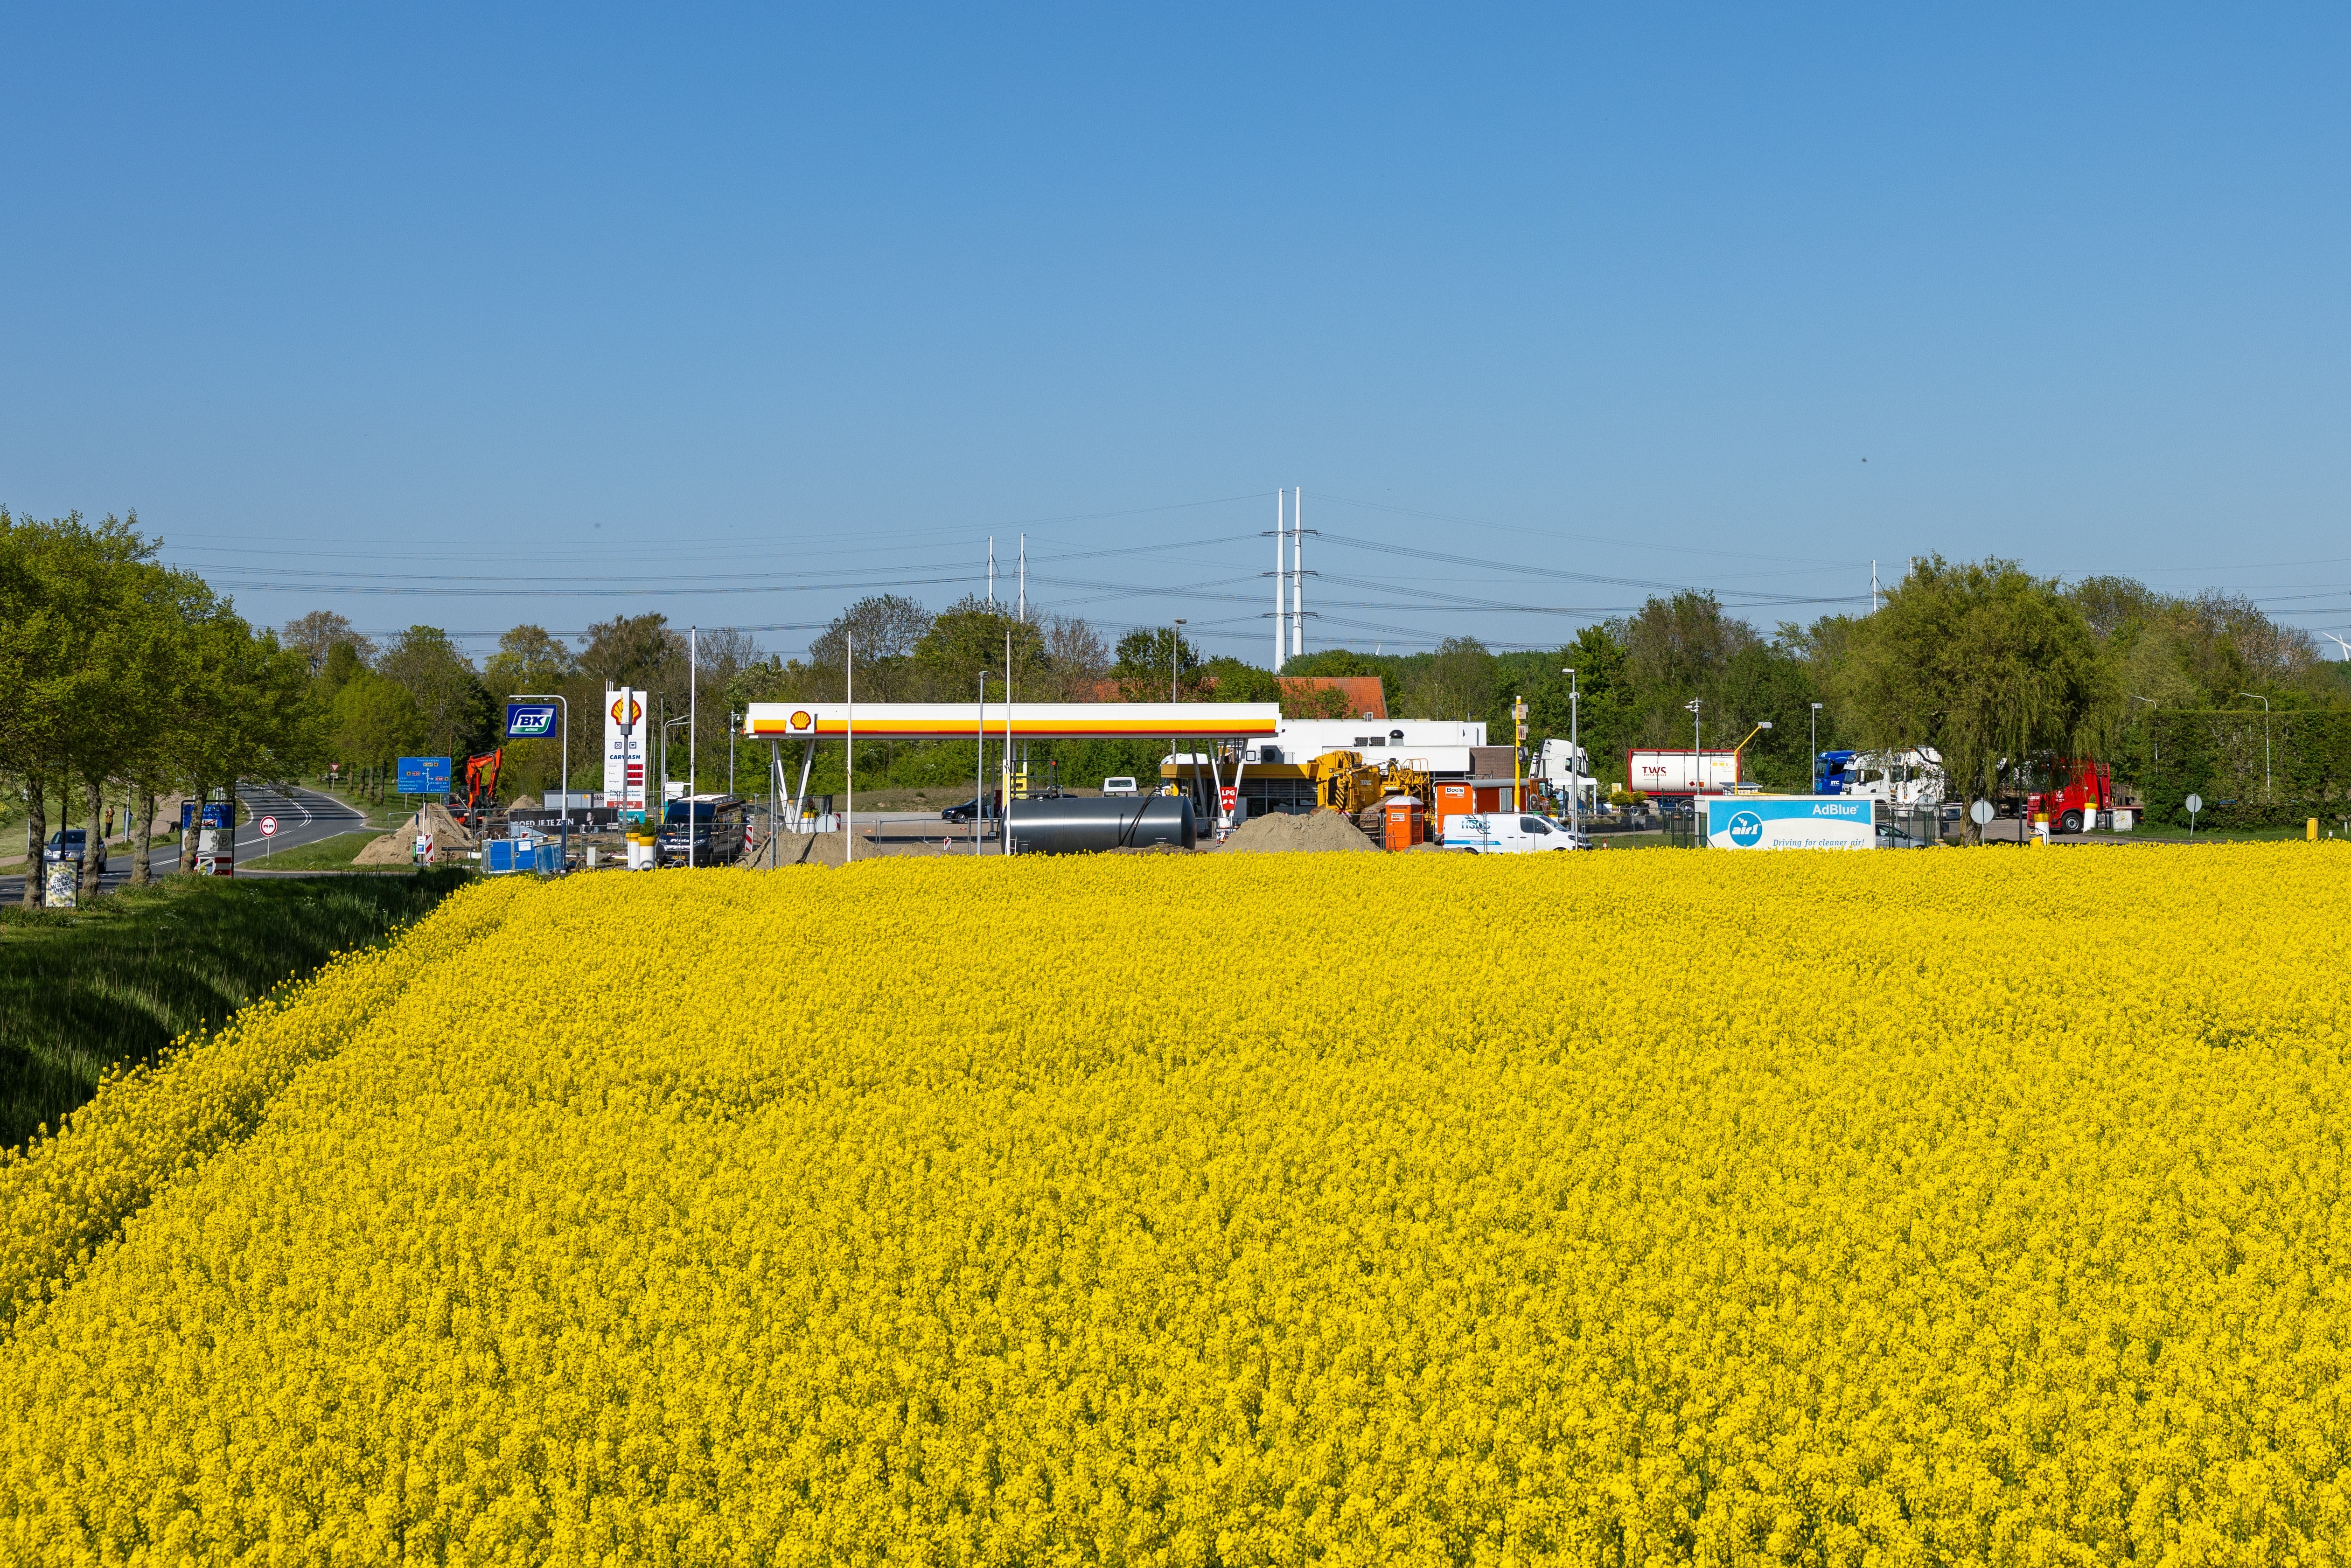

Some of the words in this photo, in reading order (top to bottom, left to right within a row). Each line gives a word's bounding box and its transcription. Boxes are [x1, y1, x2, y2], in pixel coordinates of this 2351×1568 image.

[519, 716, 545, 726] BK
[1812, 804, 1857, 815] AdBlue
[1731, 823, 1758, 835] air1
[1773, 839, 1802, 847] Driving
[1805, 839, 1816, 847] for
[50, 880, 73, 889] waste
